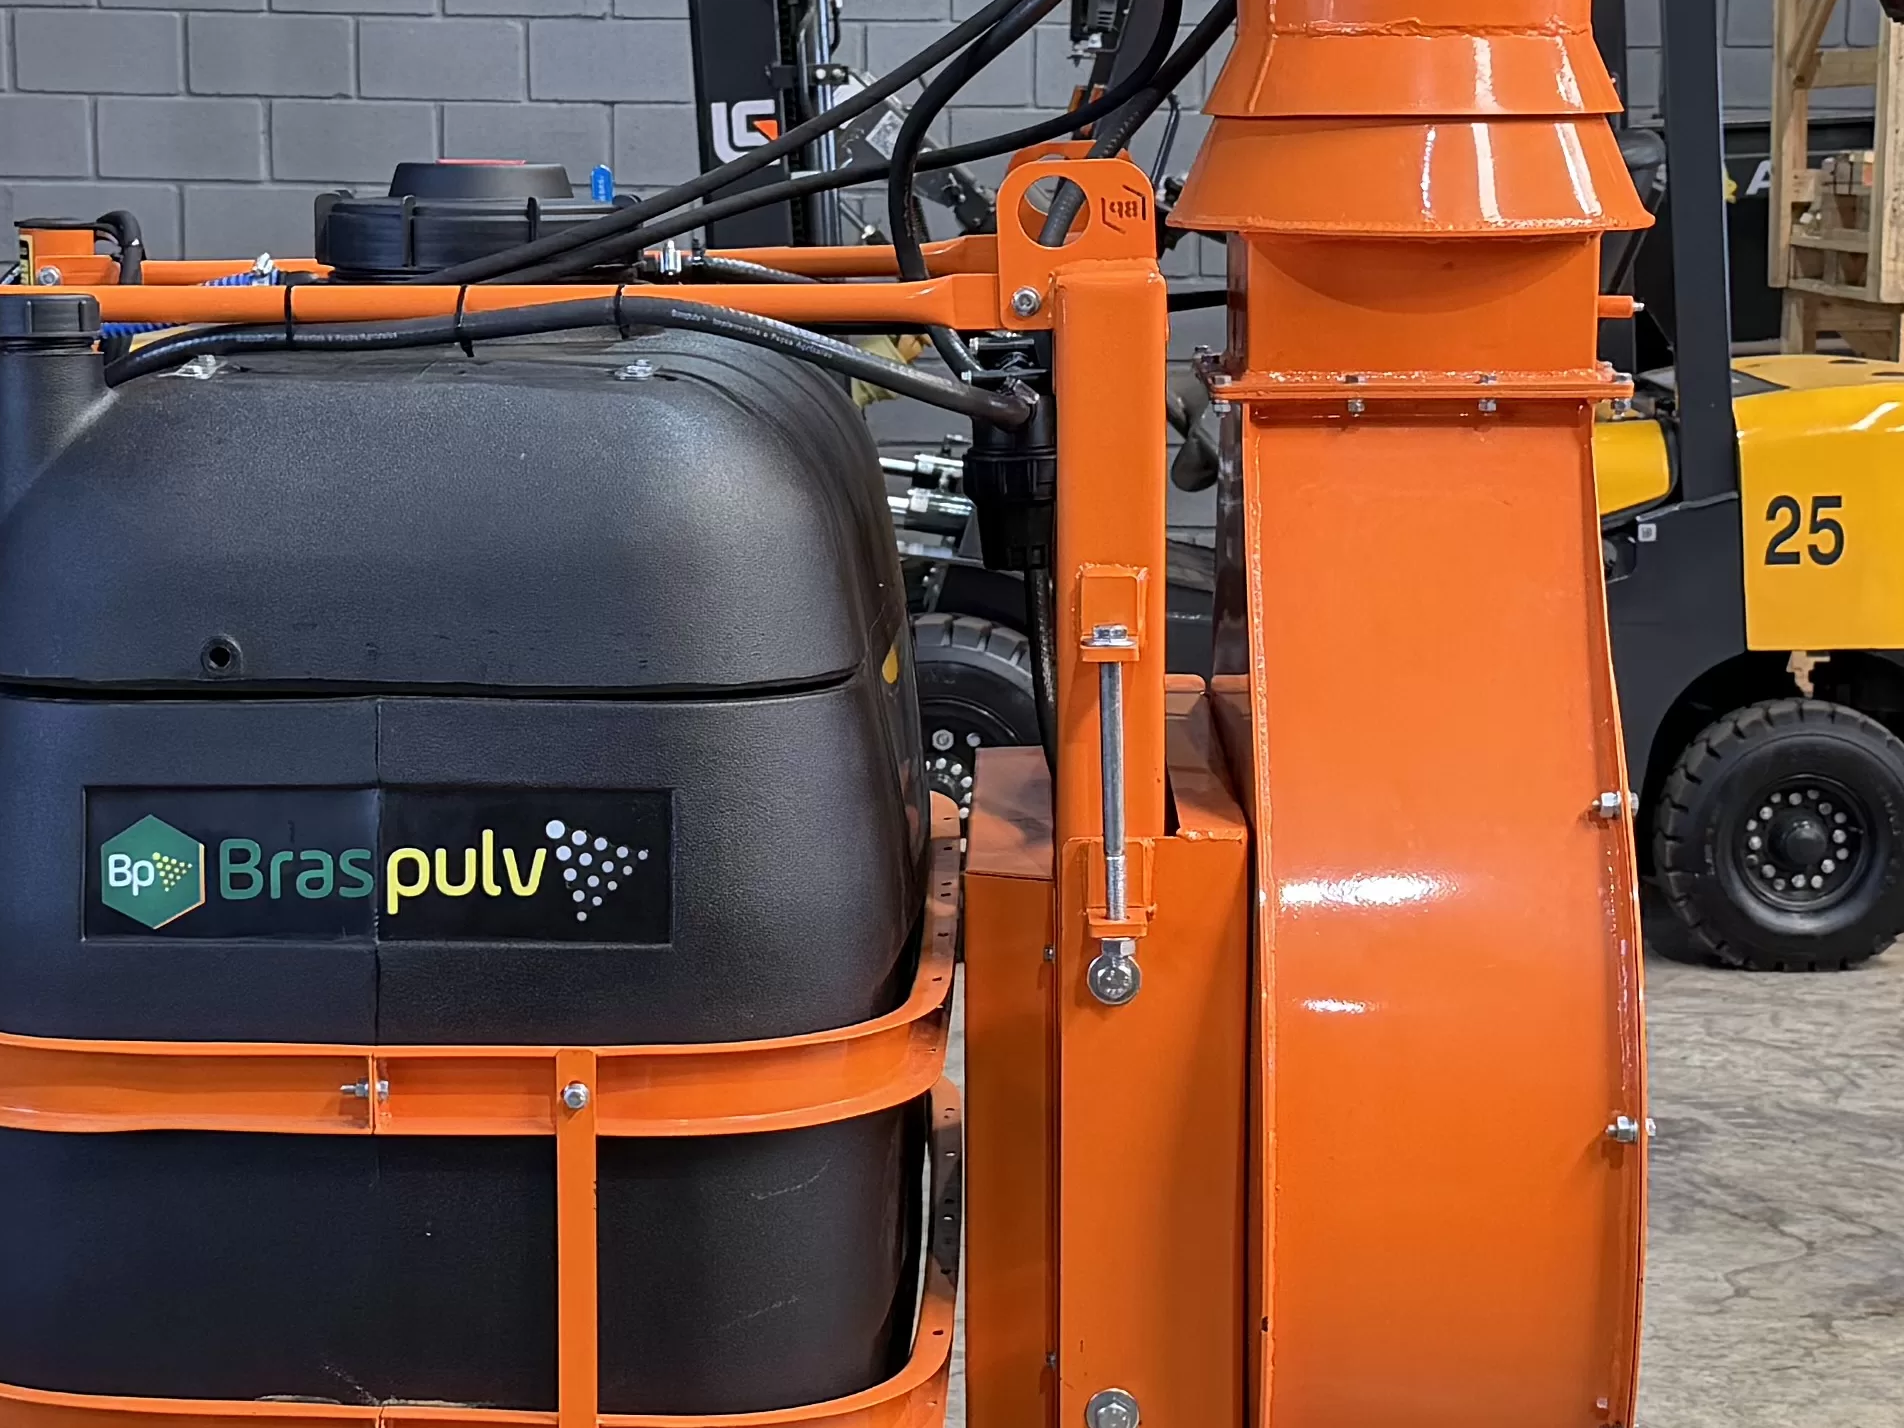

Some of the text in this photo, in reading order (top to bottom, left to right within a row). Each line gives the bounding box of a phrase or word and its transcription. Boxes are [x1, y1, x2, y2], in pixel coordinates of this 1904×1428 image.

[1764, 495, 1845, 566] 25
[108, 853, 154, 896] Bp
[218, 829, 548, 915] Braspulv
